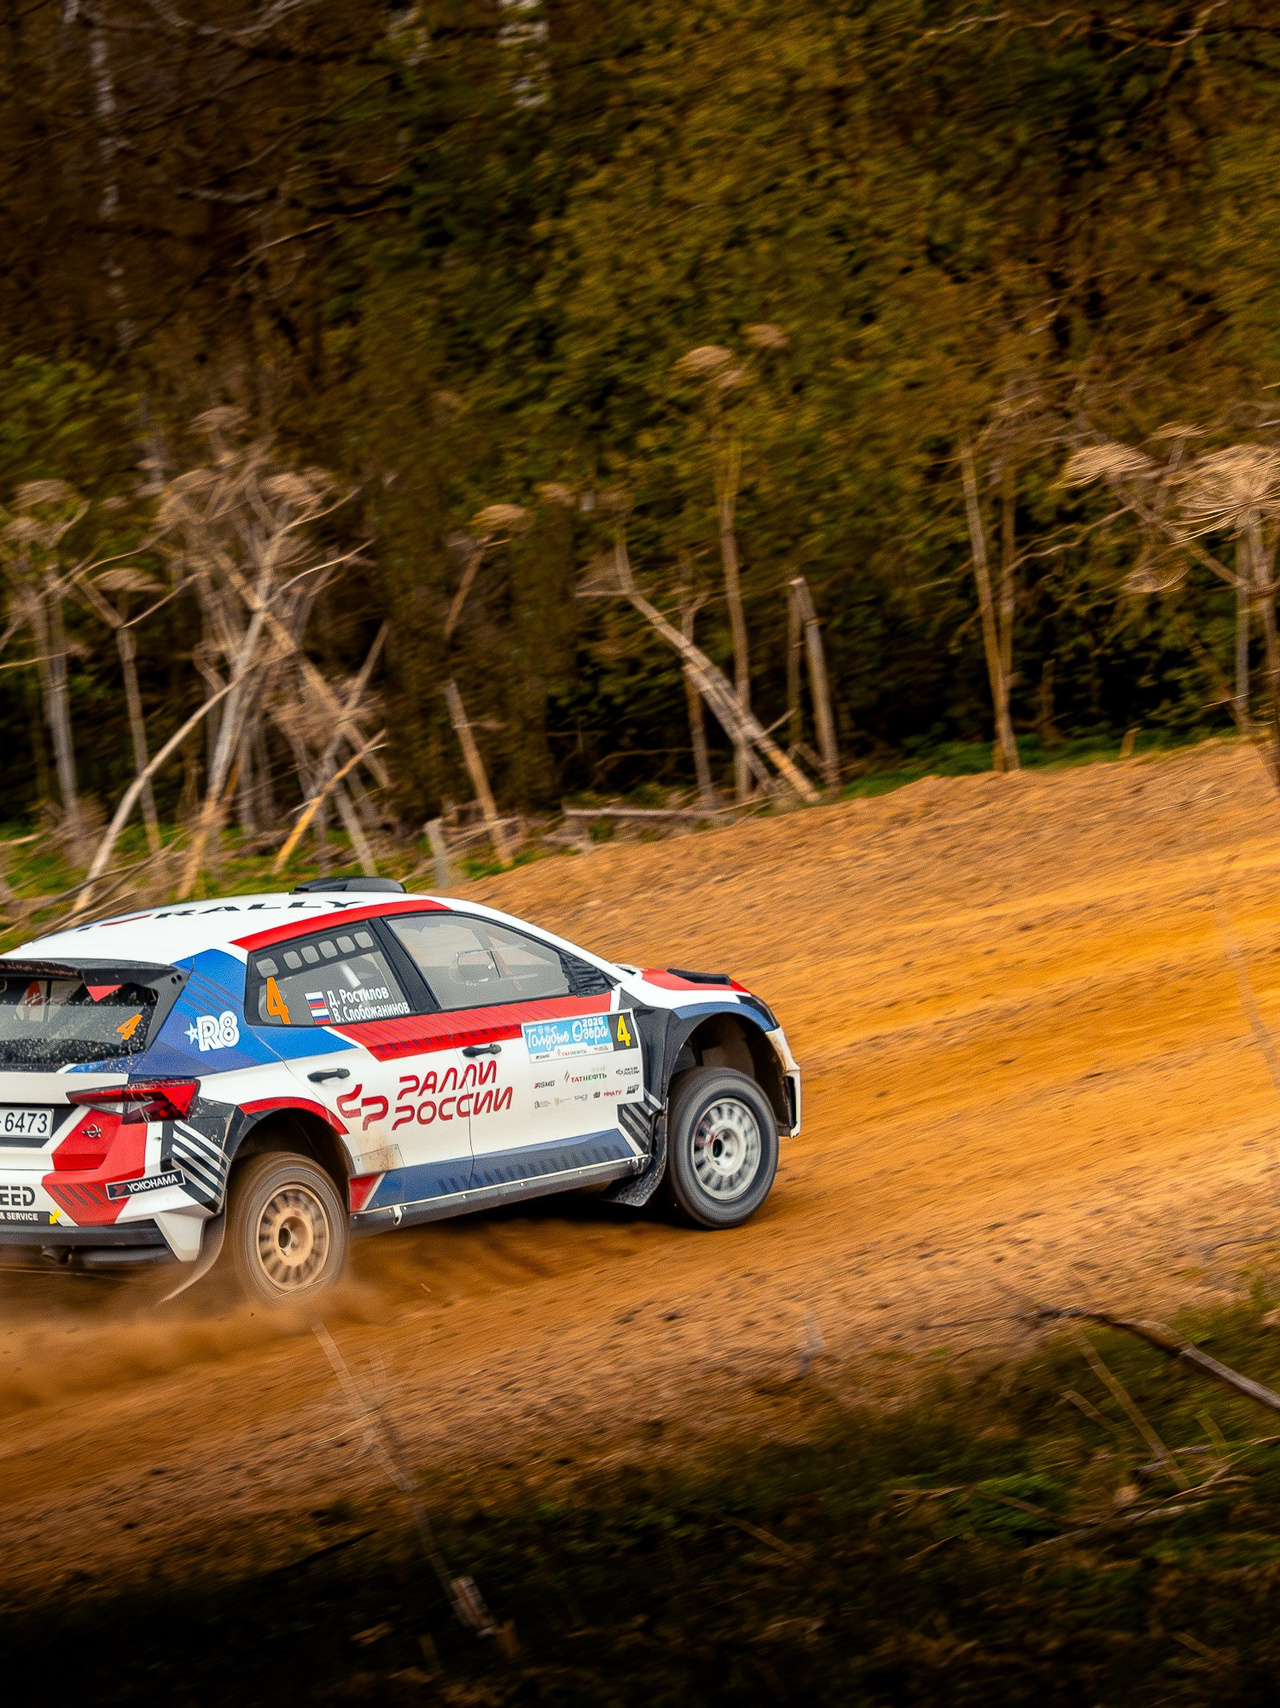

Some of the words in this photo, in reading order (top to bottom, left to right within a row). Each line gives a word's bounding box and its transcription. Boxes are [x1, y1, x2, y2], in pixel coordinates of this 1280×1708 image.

[266, 977, 291, 1024] 4
[327, 990, 340, 1009] Д.
[340, 986, 389, 1003] Ростилов
[333, 1009, 343, 1023] В.
[345, 1001, 410, 1021] Слобожанинов
[116, 1014, 143, 1040] 4
[196, 1010, 240, 1051] R8
[617, 1015, 631, 1047] 4
[397, 1060, 497, 1100] РАЛЛИ
[571, 1072, 607, 1083] ТАТНЕФТЬ
[391, 1086, 513, 1131] РОССИИ
[127, 1174, 178, 1192] YOKOHAMA
[6, 1211, 39, 1221] SERVICE
